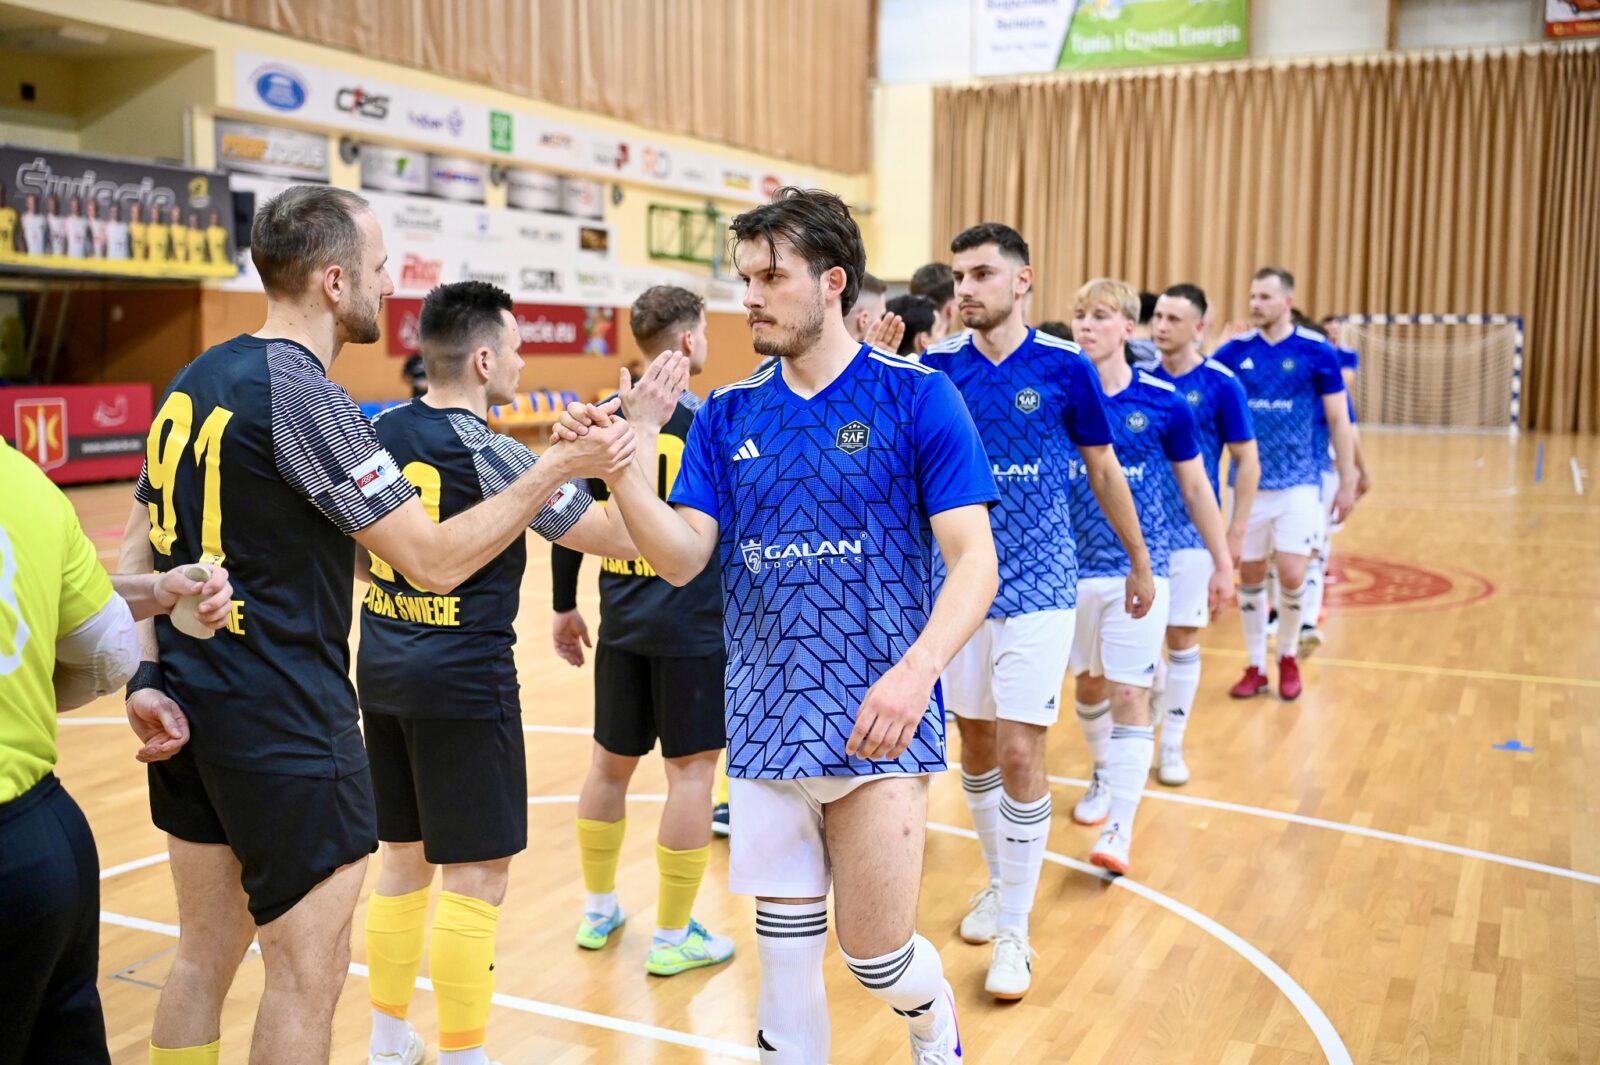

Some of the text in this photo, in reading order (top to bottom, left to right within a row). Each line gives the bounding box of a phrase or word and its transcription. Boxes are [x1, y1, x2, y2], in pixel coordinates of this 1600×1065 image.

[518, 313, 577, 343] iecie.eu
[841, 431, 864, 443] SAF
[147, 391, 234, 566] 91
[993, 463, 1039, 475] LAN
[764, 540, 862, 559] GALAN
[765, 556, 862, 570] LOGISTICS
[395, 592, 460, 626] ŚWIECIE
